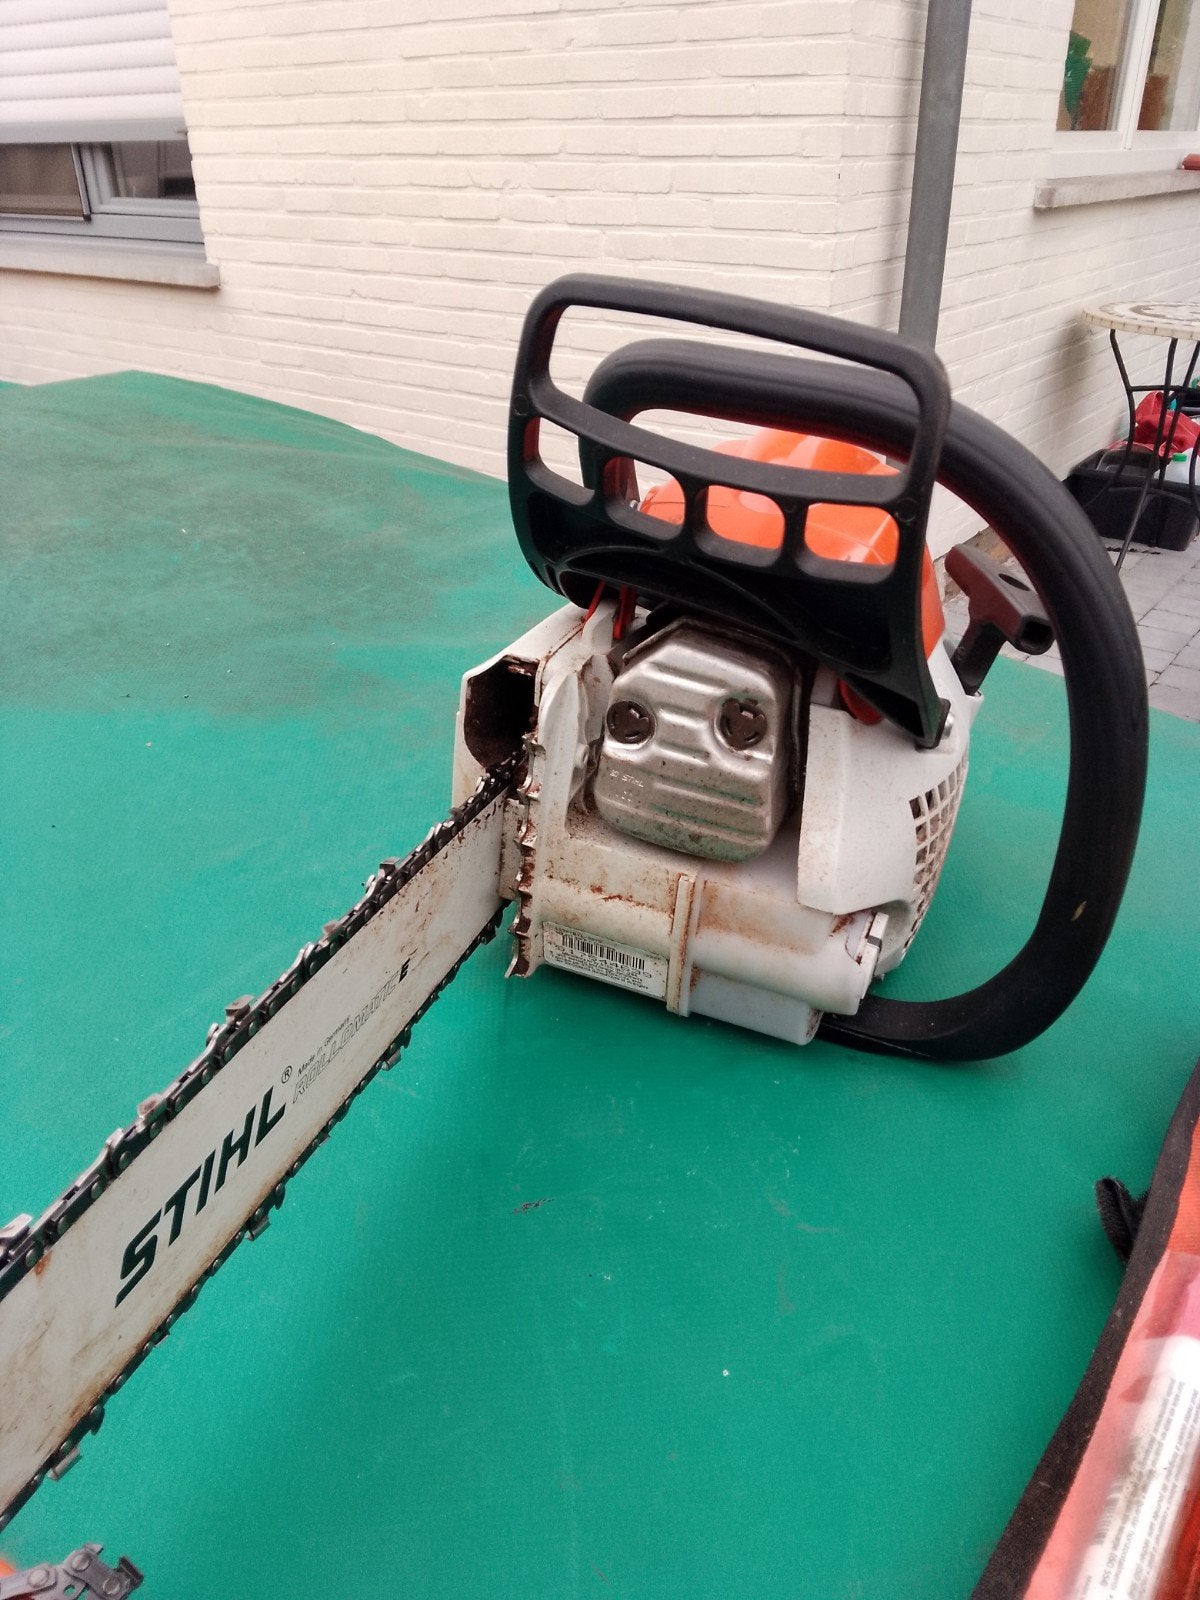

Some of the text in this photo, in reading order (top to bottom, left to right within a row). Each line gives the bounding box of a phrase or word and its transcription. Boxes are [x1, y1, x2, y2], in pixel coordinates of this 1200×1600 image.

[293, 958, 411, 1104] ROLLOMATIC E
[114, 1085, 287, 1309] STIHL
